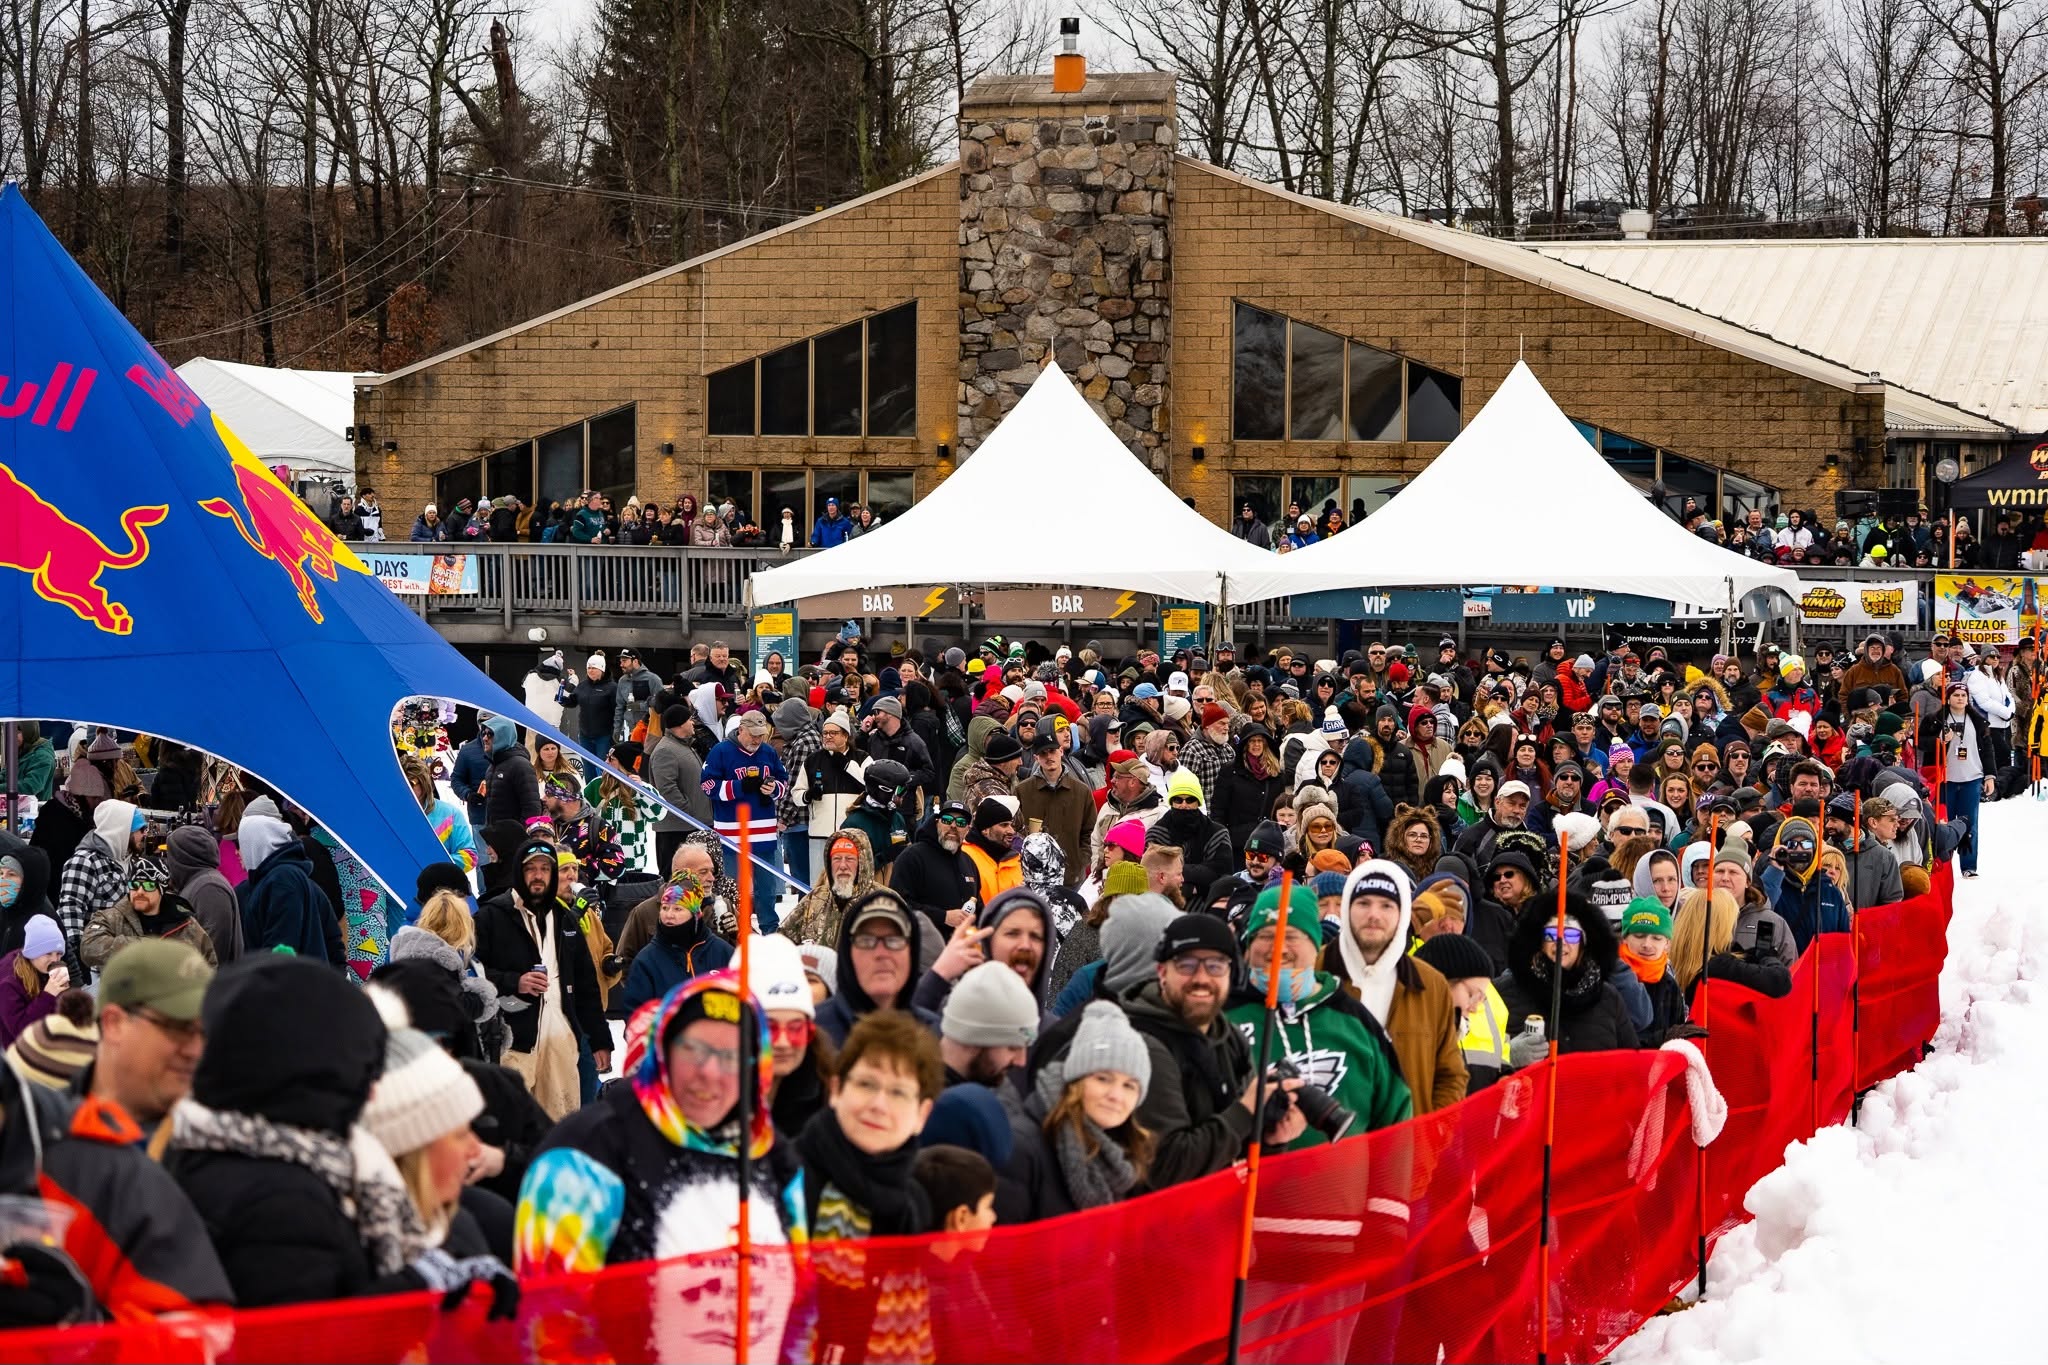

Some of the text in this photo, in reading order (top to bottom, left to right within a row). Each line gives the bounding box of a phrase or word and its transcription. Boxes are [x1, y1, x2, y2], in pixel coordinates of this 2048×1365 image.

[375, 560, 408, 577] DAYS
[1810, 588, 1835, 597] 93.3
[1861, 589, 1903, 602] PRESTON
[862, 594, 894, 612] BAR
[1051, 595, 1084, 613] BAR
[1362, 595, 1391, 615] VIP
[1566, 598, 1596, 618] VIP
[1801, 597, 1845, 608] WMMR
[1871, 602, 1902, 614] STEVE
[1939, 620, 2007, 630] CERVEZA OF
[1963, 632, 2005, 643] SLOPES
